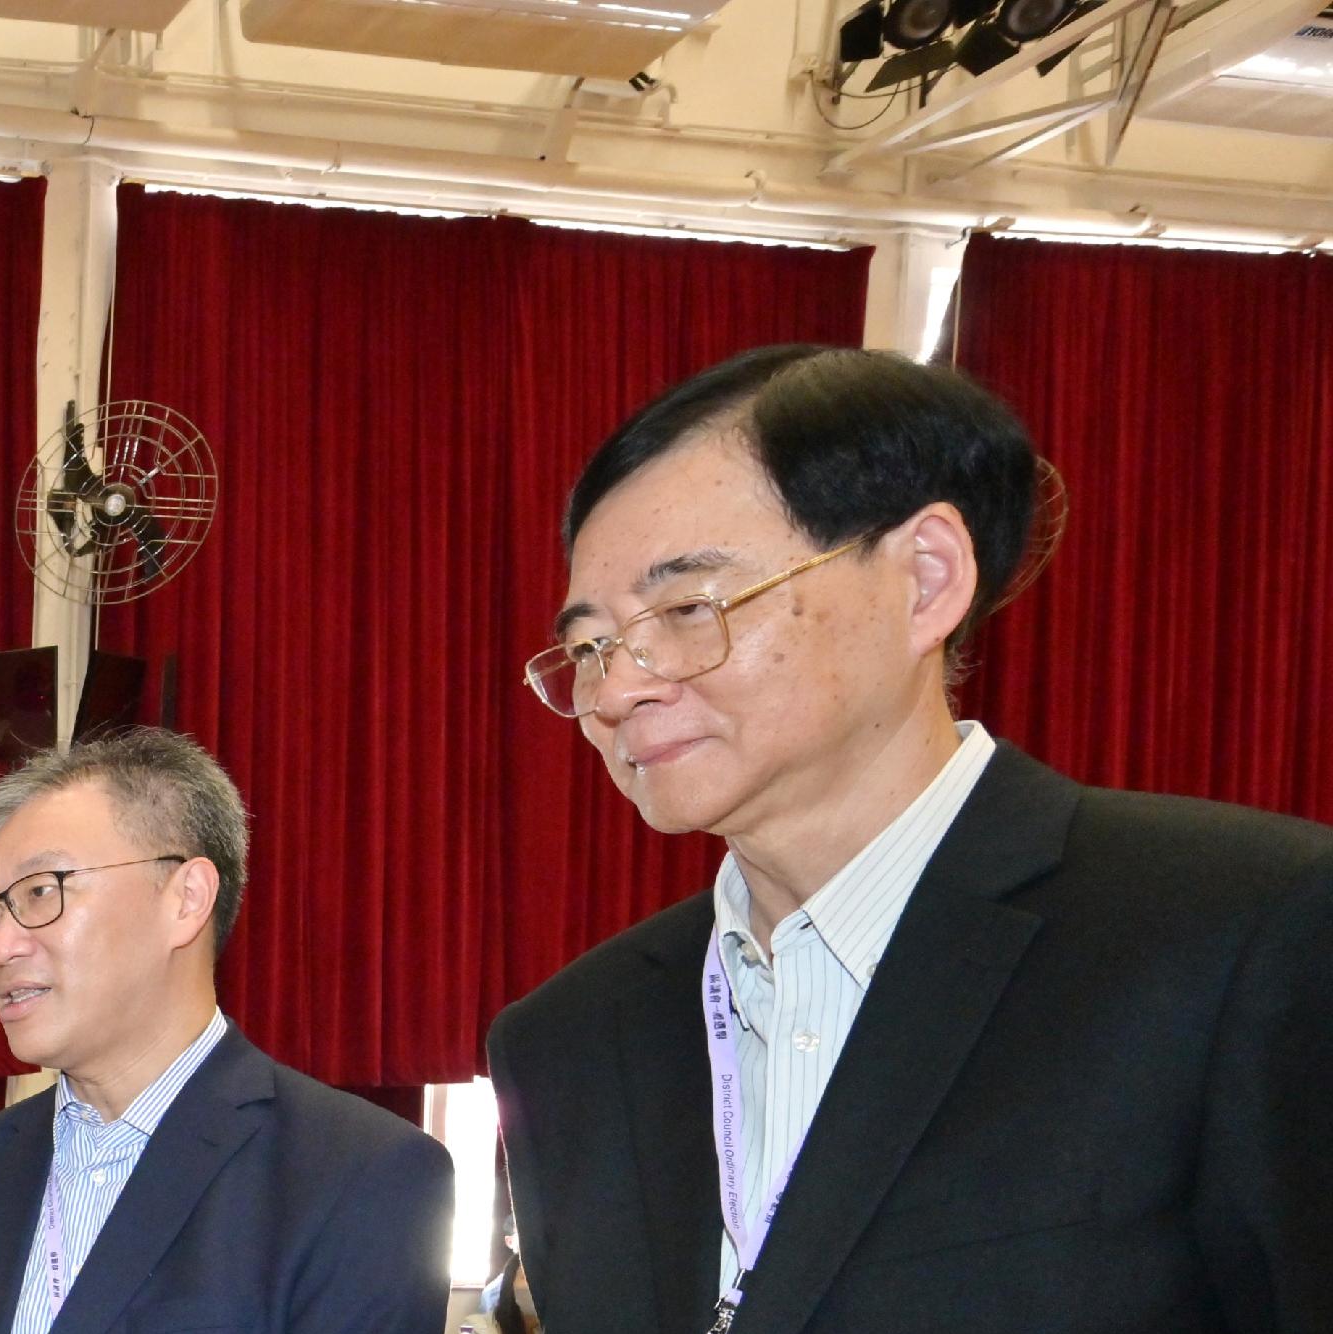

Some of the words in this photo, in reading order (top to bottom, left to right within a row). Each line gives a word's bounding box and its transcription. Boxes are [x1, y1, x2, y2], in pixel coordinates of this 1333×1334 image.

[721, 1073, 733, 1107] District
[722, 1108, 734, 1149] Council
[724, 1149, 735, 1191] Ordinary
[728, 1192, 740, 1230] Election
